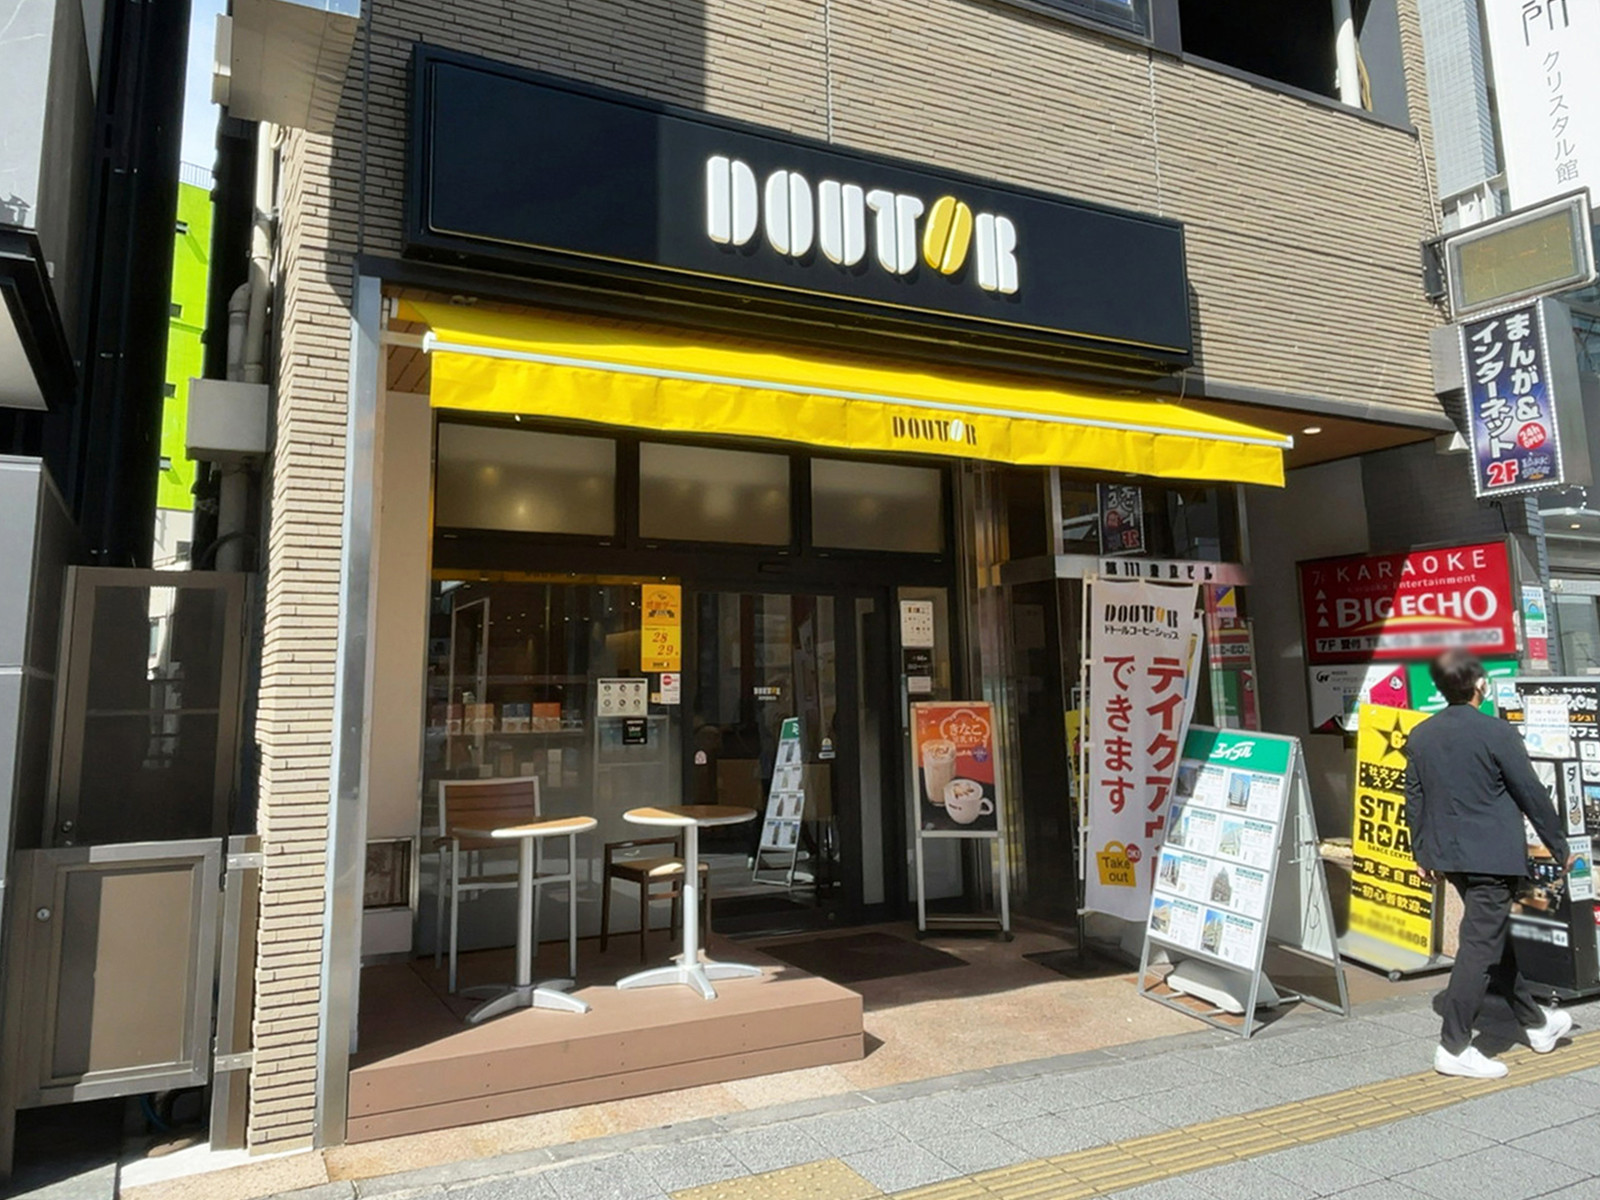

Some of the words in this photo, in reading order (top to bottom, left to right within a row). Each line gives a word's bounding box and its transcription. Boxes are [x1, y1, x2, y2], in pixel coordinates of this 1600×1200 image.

[1543, 51, 1579, 184] クリスタル館
[707, 156, 1019, 294] DOUTOR
[1505, 313, 1543, 421] まんが&
[1471, 320, 1515, 459] インターネット
[893, 416, 977, 446] DOUTOR
[1487, 459, 1519, 487] 2F
[1336, 549, 1488, 583] KARAOKE
[1105, 604, 1179, 628] DOUTOR
[1101, 656, 1136, 815] できます
[1101, 856, 1131, 870] Take
[1109, 872, 1129, 883] out
